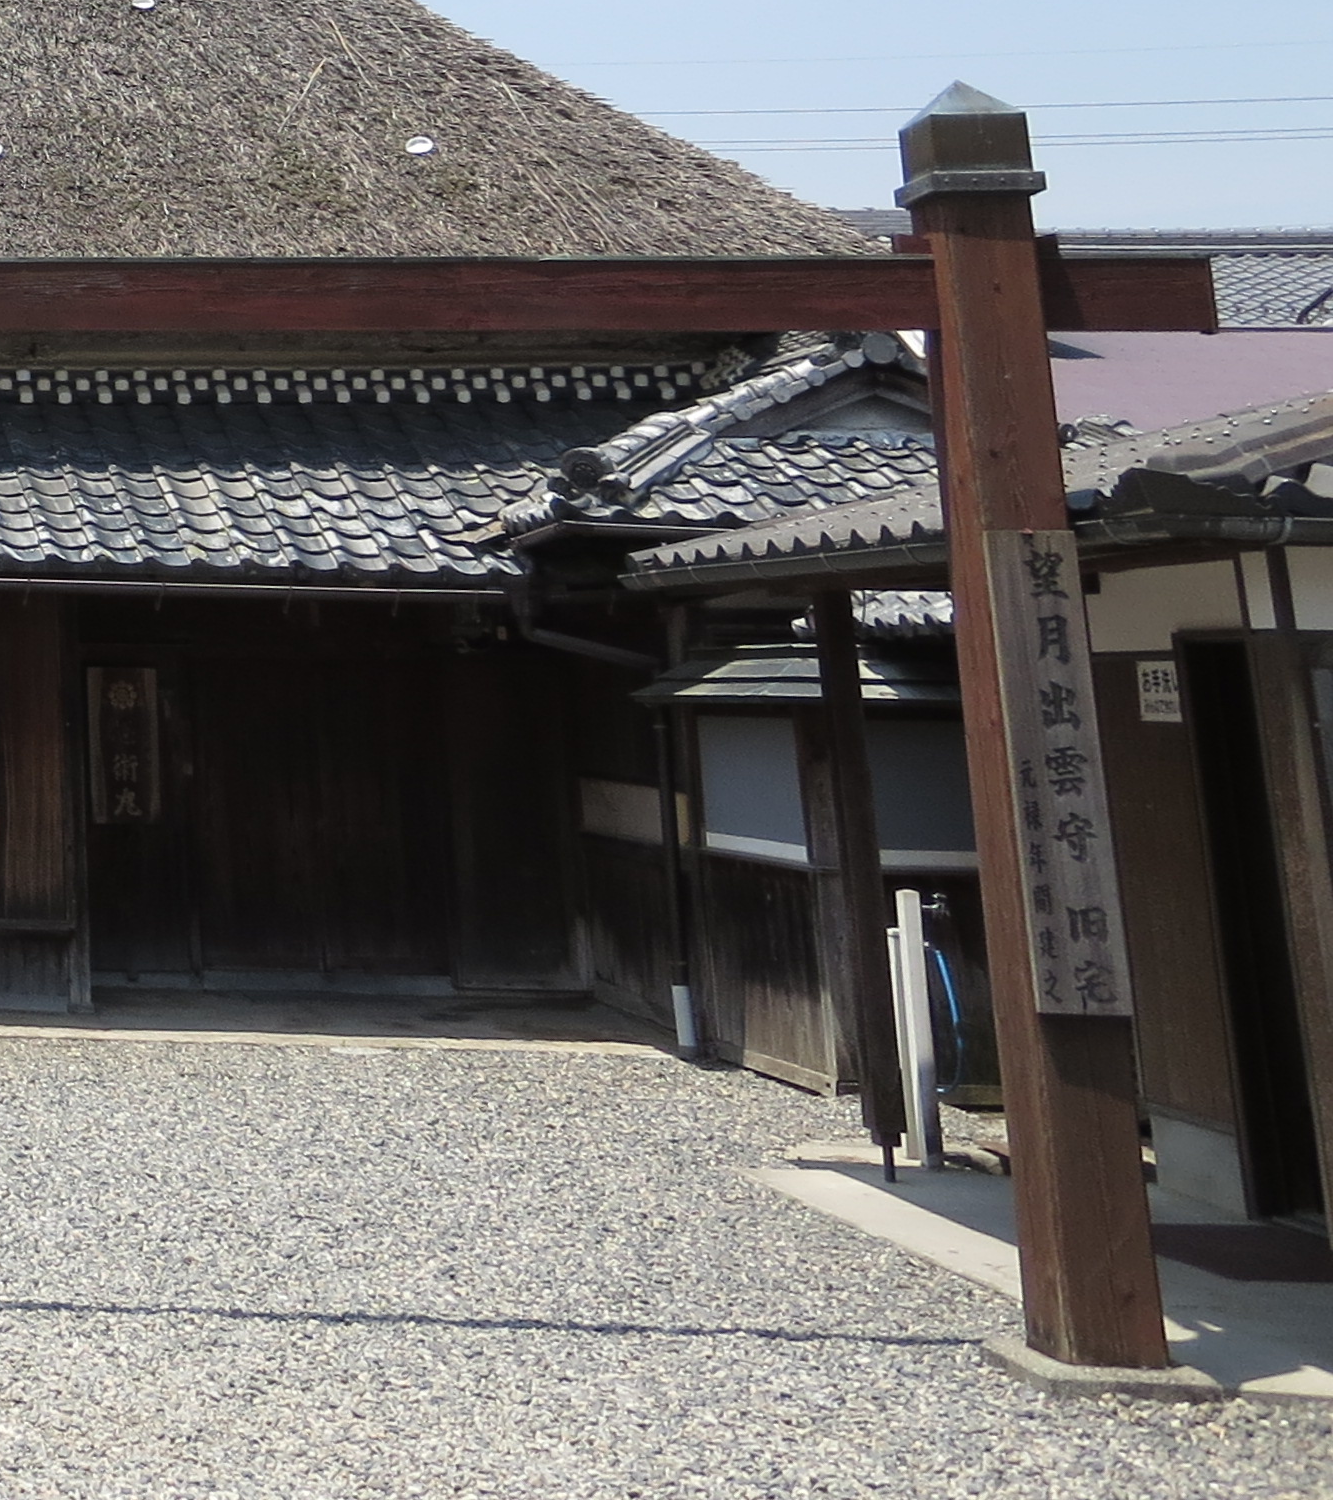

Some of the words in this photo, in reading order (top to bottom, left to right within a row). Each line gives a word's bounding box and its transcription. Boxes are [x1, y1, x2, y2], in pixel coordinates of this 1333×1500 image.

[1025, 550, 1116, 1009] 望月出雲守旧宅
